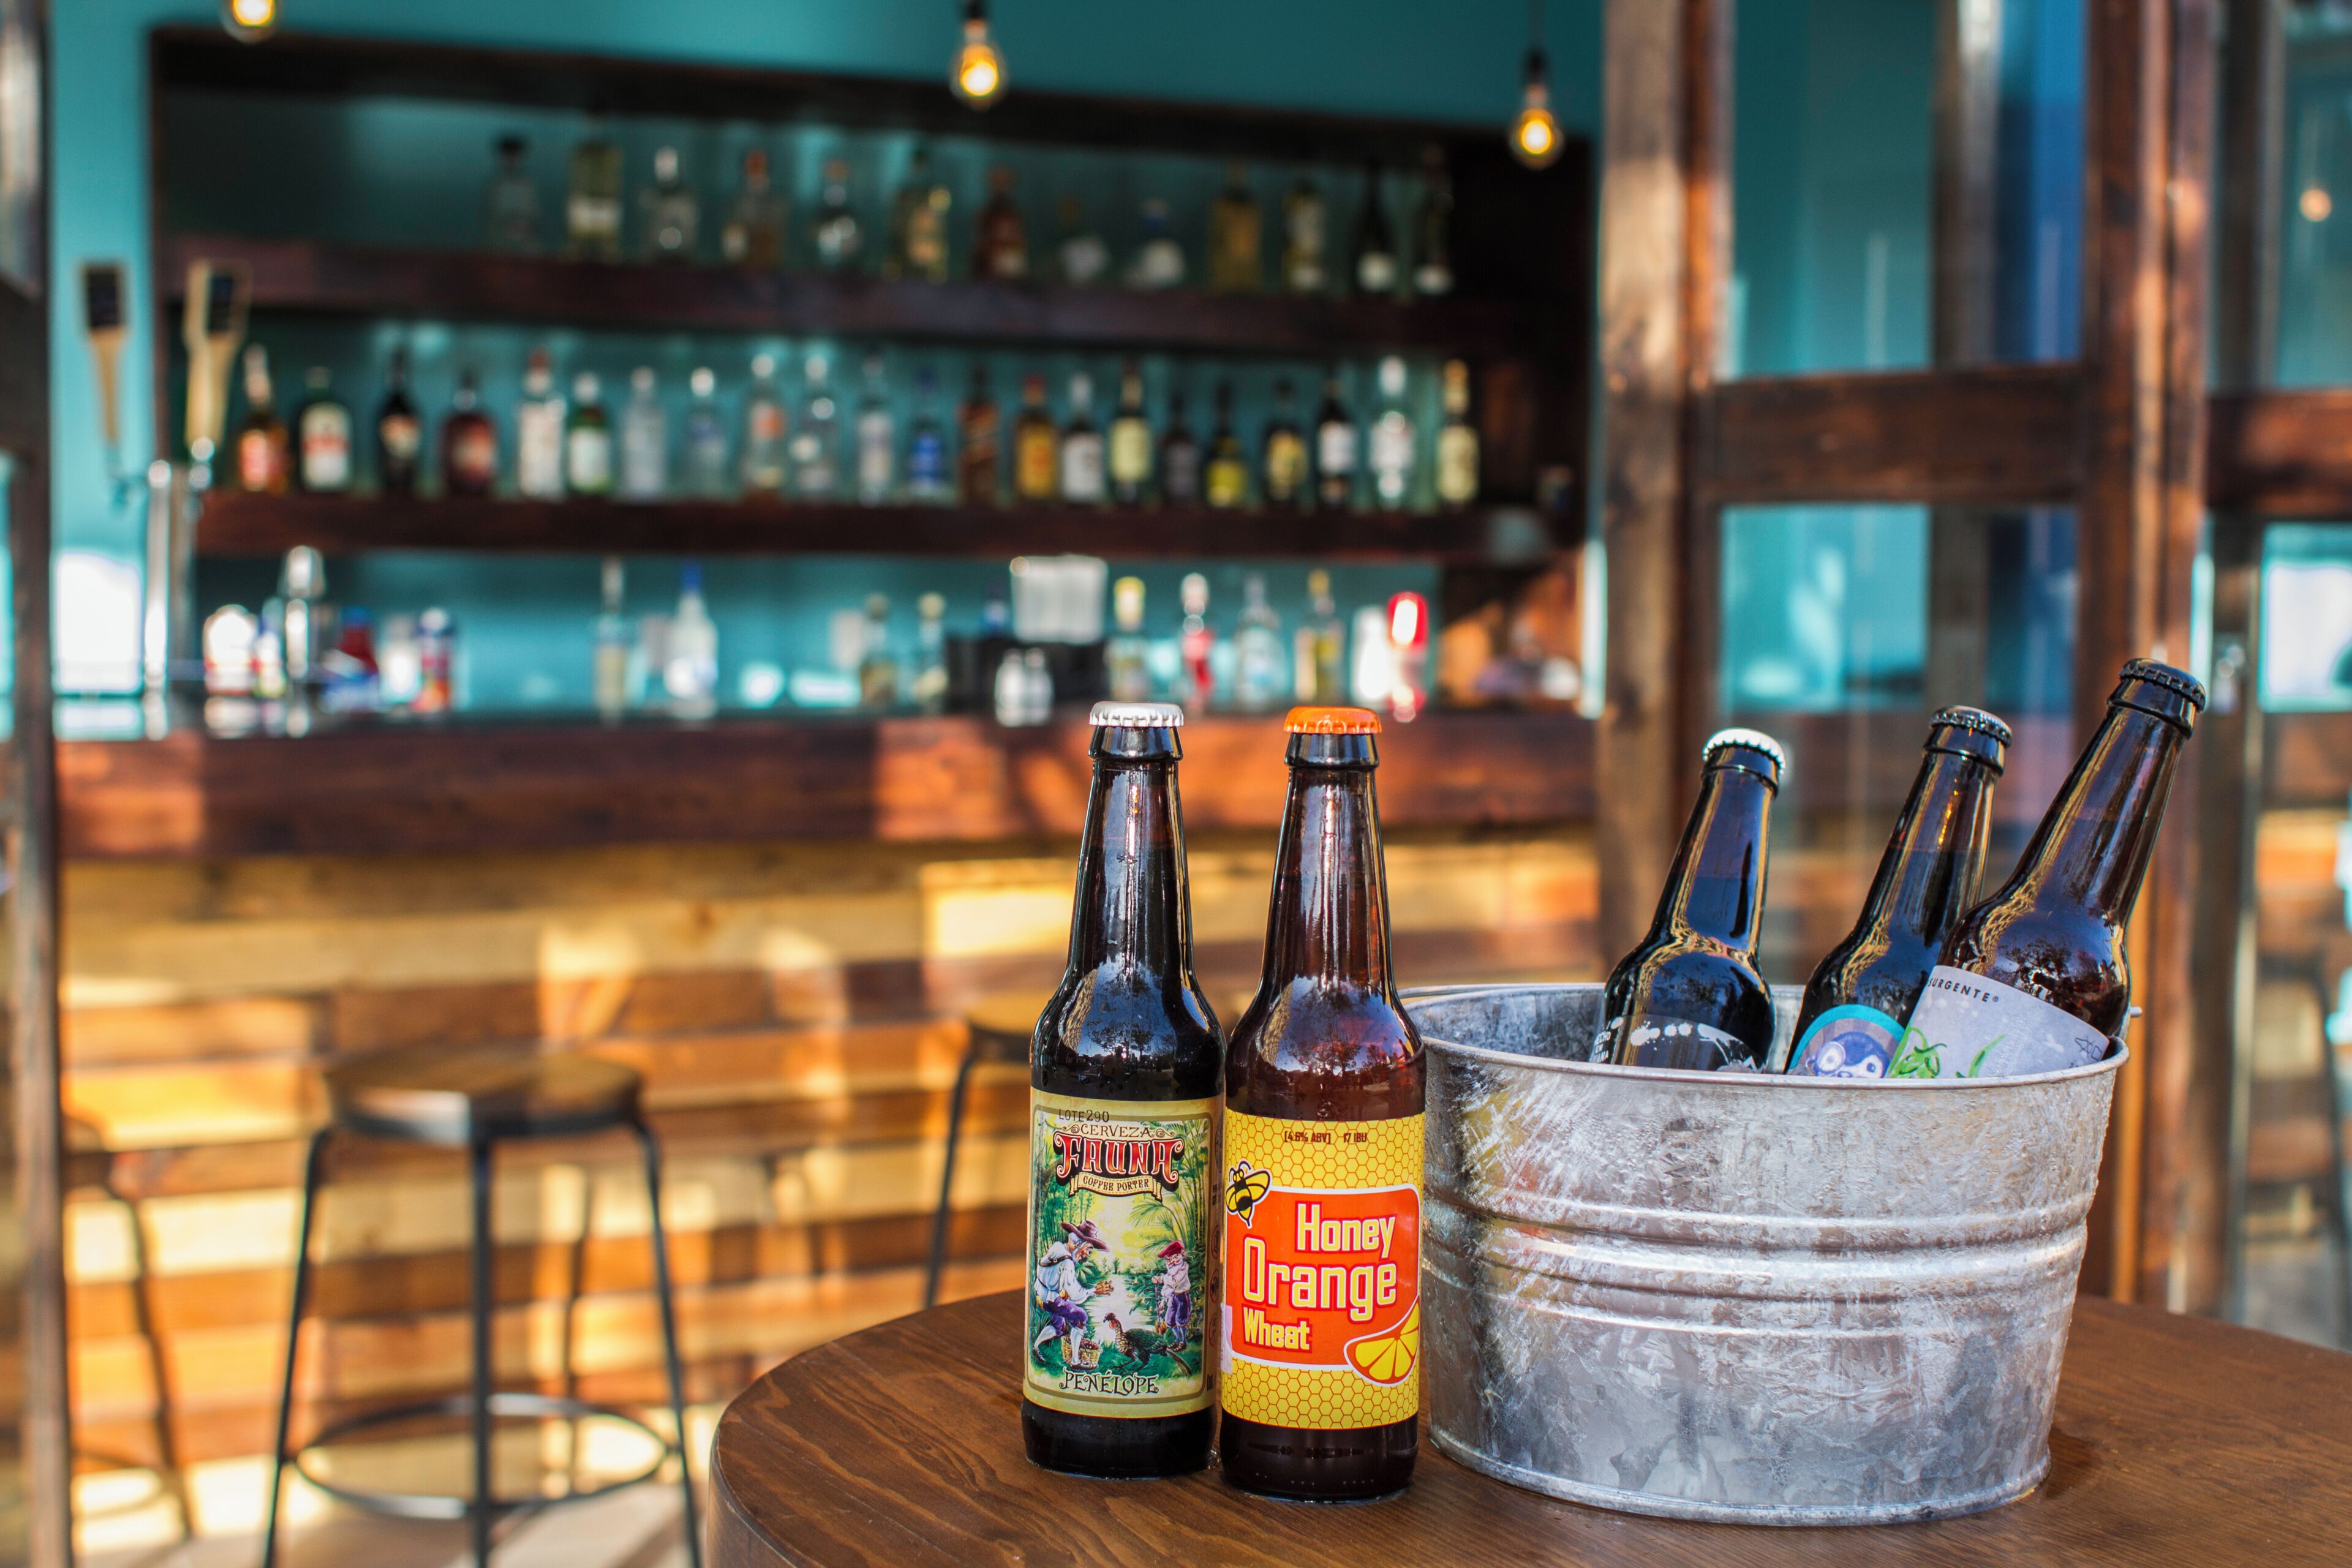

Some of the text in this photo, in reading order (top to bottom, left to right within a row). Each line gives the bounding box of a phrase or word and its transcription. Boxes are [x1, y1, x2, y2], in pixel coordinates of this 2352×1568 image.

[1080, 1123, 1155, 1138] CERVEZA
[1311, 1133, 1331, 1145] ABV]
[1354, 1132, 1368, 1143] IBU
[1054, 1132, 1186, 1185] FAUNA
[1083, 1175, 1150, 1191] COFFEE PORTER
[1296, 1202, 1396, 1259] Honey
[1243, 1236, 1397, 1322] Orange
[1242, 1306, 1311, 1351] Wheat
[1058, 1366, 1159, 1396] PENÉLOPE
